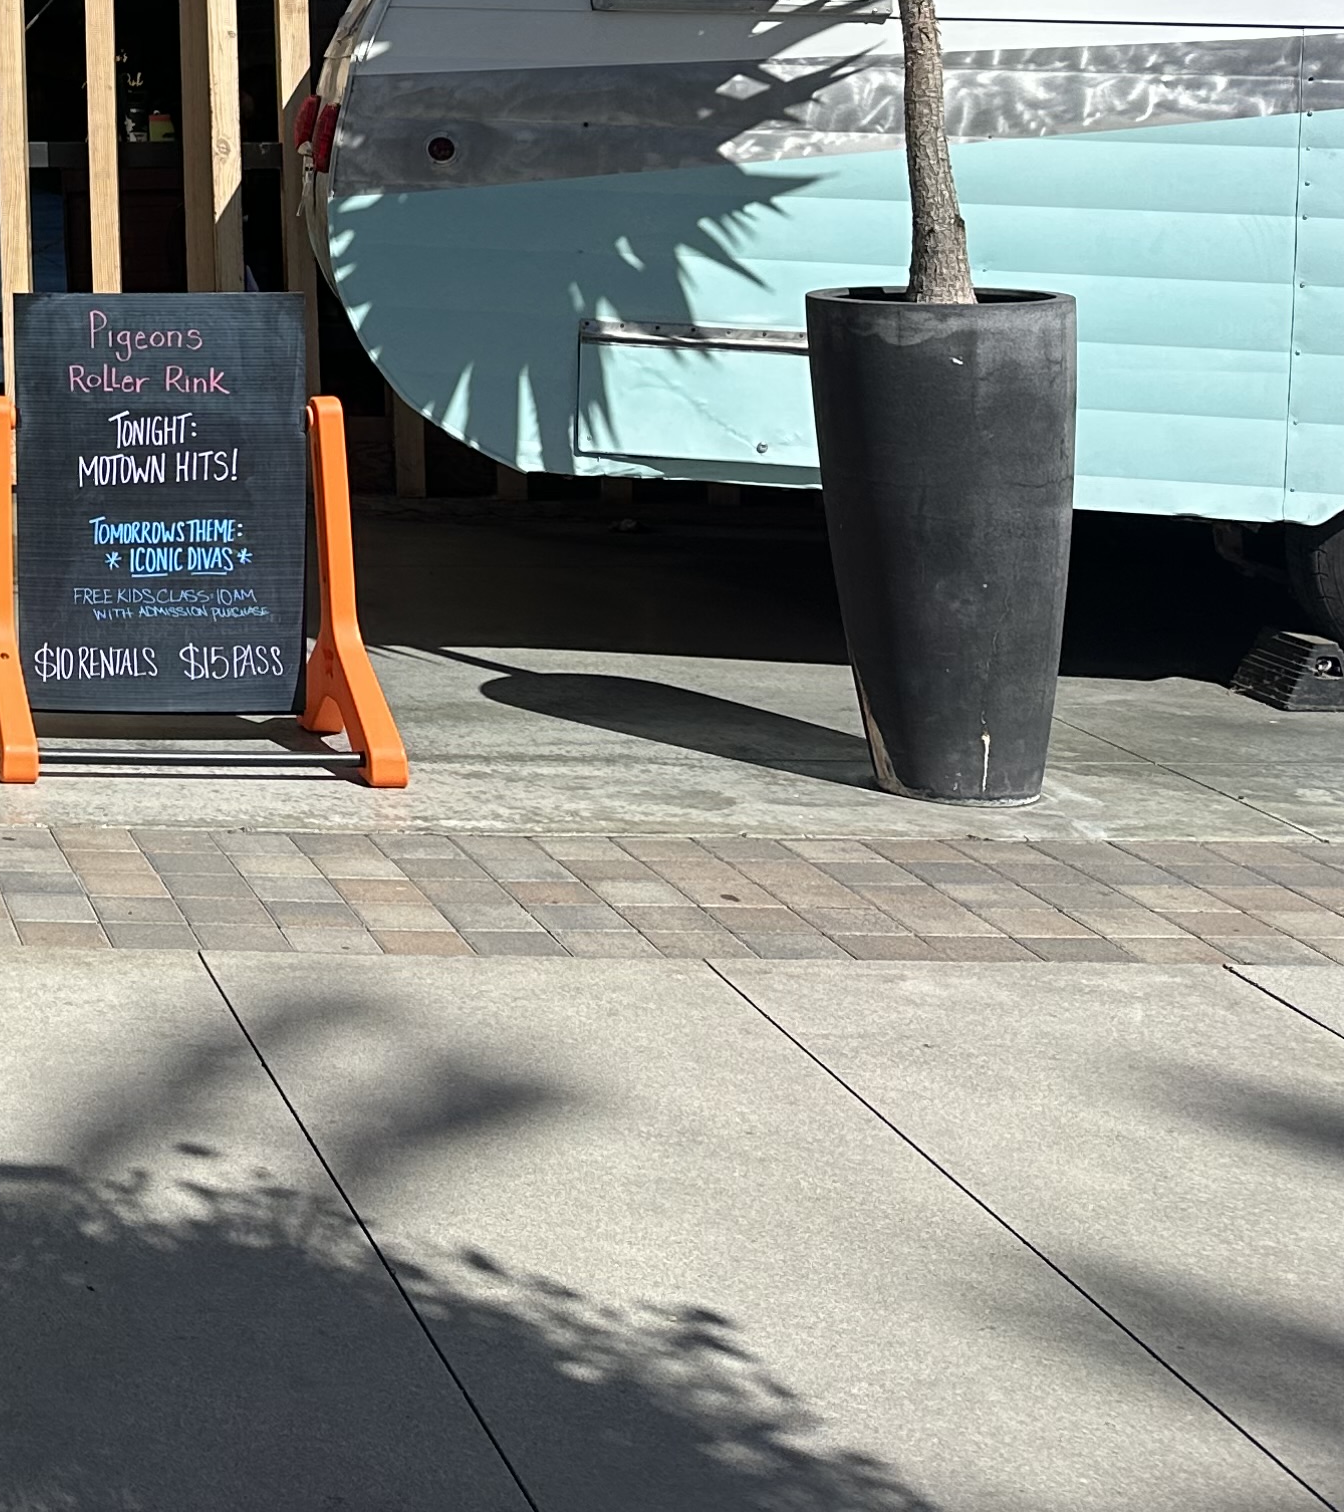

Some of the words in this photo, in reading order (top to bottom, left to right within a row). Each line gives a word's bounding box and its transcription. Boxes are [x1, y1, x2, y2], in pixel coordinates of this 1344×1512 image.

[89, 309, 203, 362] Pigeons
[165, 365, 230, 395] Rink
[108, 410, 197, 449] TONIGHT:
[78, 452, 166, 488] MOTOWN
[175, 448, 239, 483] HITS!
[89, 516, 185, 545] TOMORROWS
[186, 519, 243, 543] THEME:
[130, 547, 183, 573] ICONIC
[187, 546, 234, 572] DIVAS
[73, 588, 113, 605] FREE
[116, 588, 156, 604] KIDS
[93, 607, 133, 621] WITH
[138, 605, 209, 618] ADMISSION
[34, 642, 75, 683] $10
[78, 646, 158, 680] RENTALS
[179, 642, 229, 681] $15
[233, 644, 284, 679] PASS
